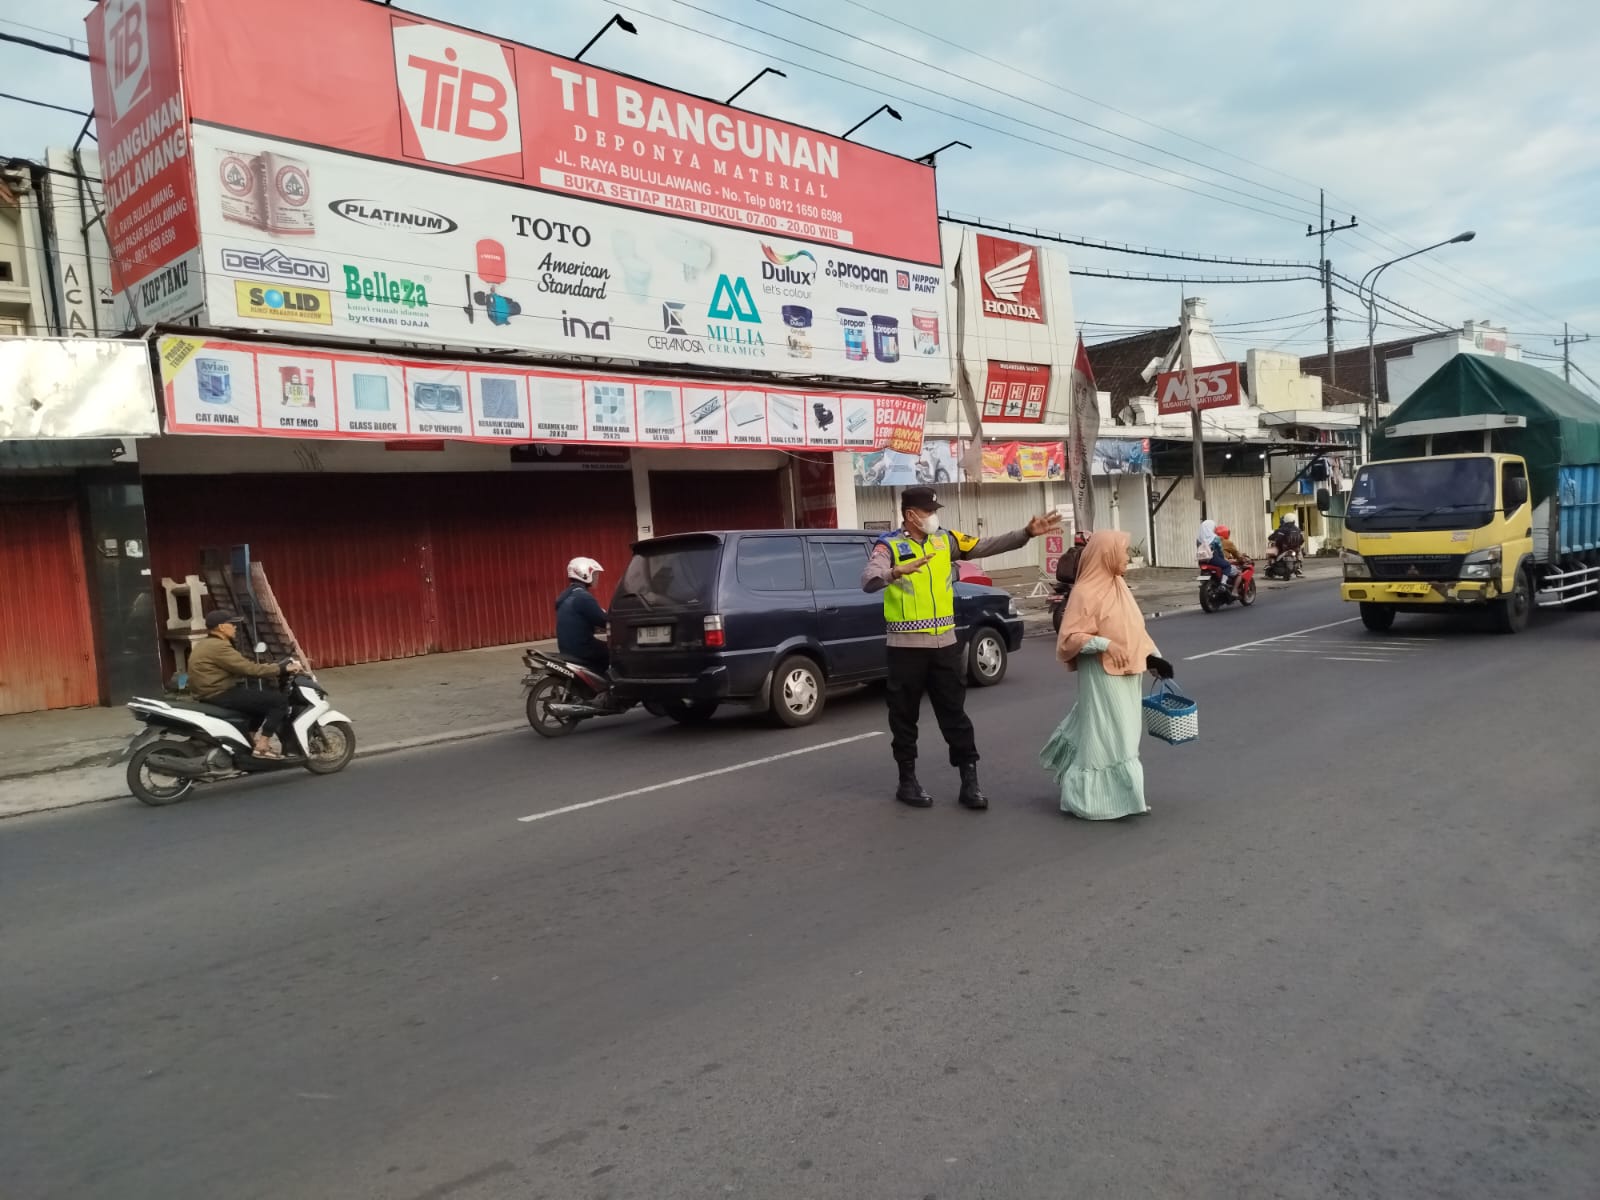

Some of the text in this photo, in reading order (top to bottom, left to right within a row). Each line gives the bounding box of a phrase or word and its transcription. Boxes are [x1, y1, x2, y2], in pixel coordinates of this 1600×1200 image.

[551, 66, 839, 179] TI BANGUNAN
[109, 93, 182, 178] BANGUNAN
[574, 125, 828, 198] DEPONYA MATERIAL
[555, 150, 576, 167] JL.
[580, 155, 618, 176] RAYA
[621, 165, 711, 196] BULULAWANG
[722, 187, 741, 202] No.
[744, 191, 766, 209] Telp
[769, 197, 793, 213] 0812
[796, 203, 819, 218] 1650
[821, 208, 843, 224] 6598
[345, 203, 443, 230] PLATINUM
[564, 174, 606, 195] BUKA
[610, 184, 660, 205] SETIAP
[664, 195, 696, 213] HARI
[700, 203, 742, 222] PUKUL
[746, 212, 777, 228] 07.00
[787, 220, 816, 236] 20.00
[819, 226, 839, 240] WIB
[512, 215, 591, 248] TOTO
[538, 252, 611, 281] American
[762, 261, 811, 286] Dulux
[837, 261, 888, 284] propan
[343, 265, 429, 308] Belleza
[537, 273, 607, 300] Standard
[912, 273, 939, 286] NIPPON
[914, 284, 936, 294] PAINT
[249, 287, 321, 312] SOLID
[984, 300, 1040, 320] HONDA
[348, 313, 429, 328] by KENARI DJAJA
[648, 335, 706, 354] CERANOSA
[706, 324, 765, 346] MULIA
[708, 344, 766, 357] CERAMICS
[195, 413, 211, 422] CAT
[280, 418, 318, 427] CAT EMCO
[349, 421, 397, 431] GLASS BLOCK
